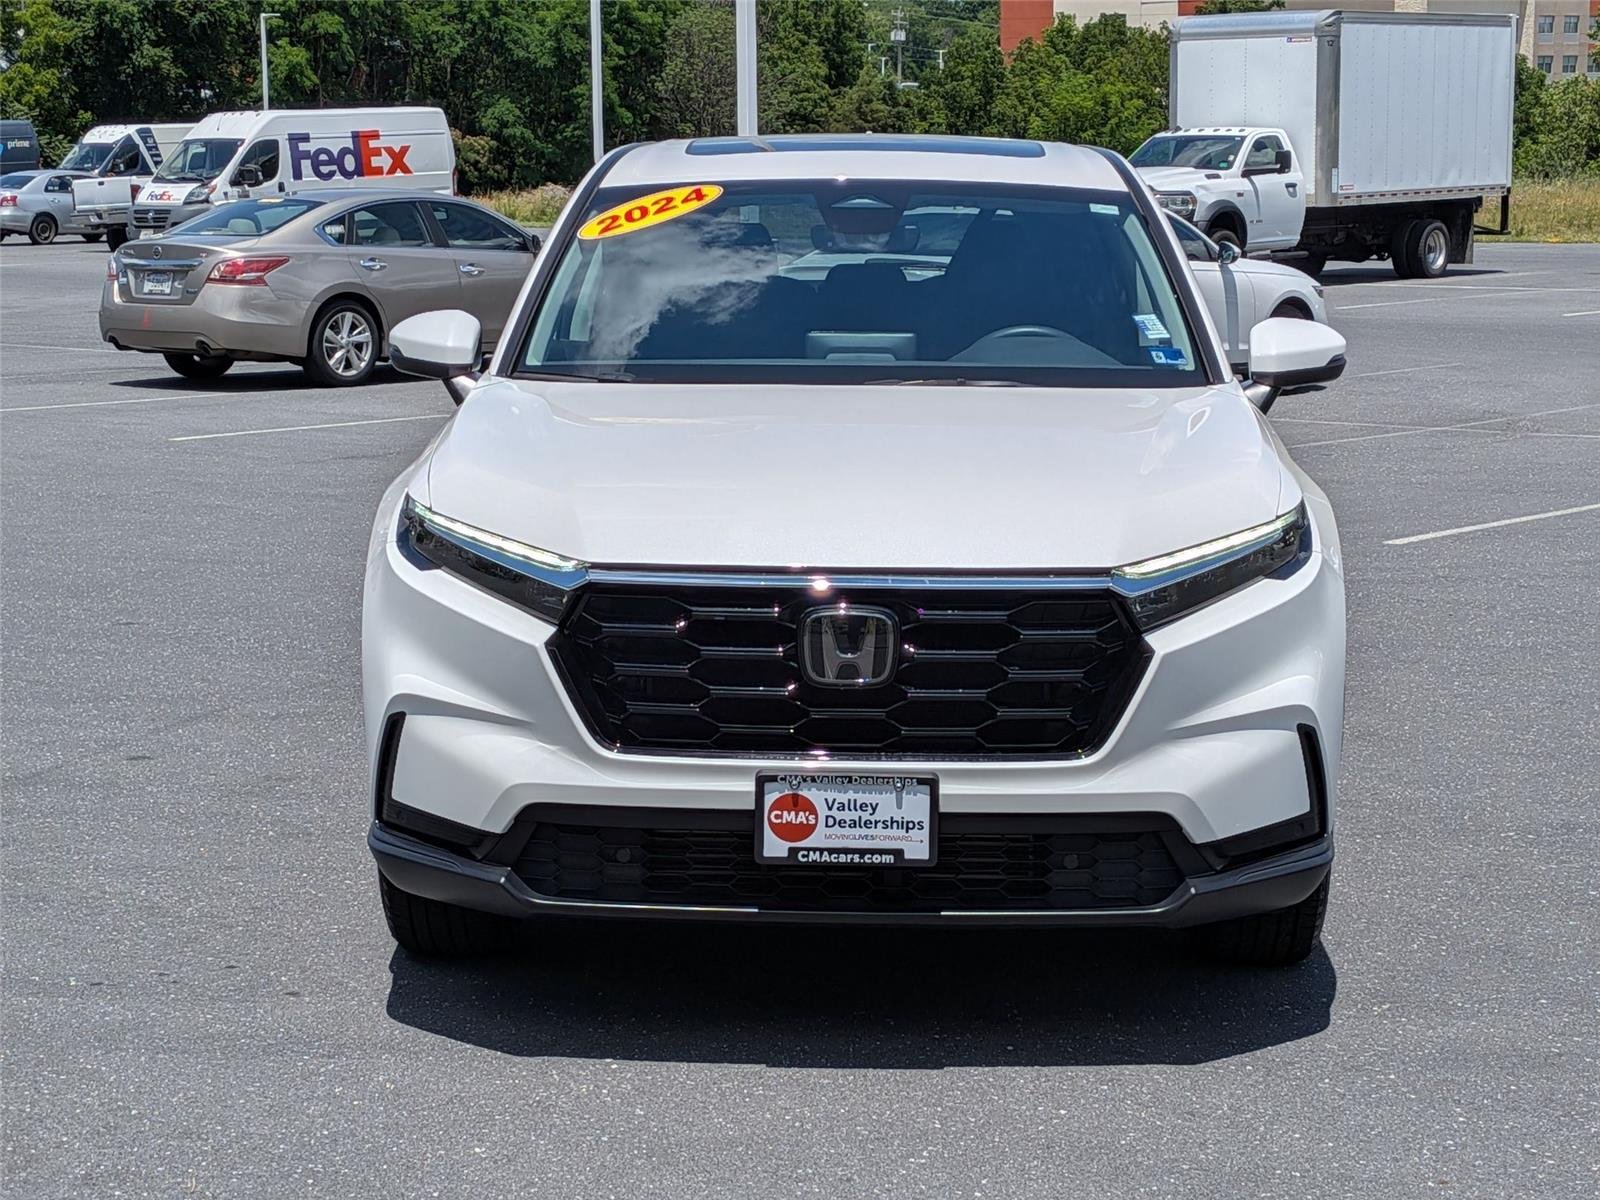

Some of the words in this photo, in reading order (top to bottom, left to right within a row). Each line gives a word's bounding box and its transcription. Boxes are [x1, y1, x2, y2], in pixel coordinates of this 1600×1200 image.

[7, 139, 30, 150] prime
[287, 129, 414, 182] FedEx
[596, 187, 710, 236] 2024
[815, 775, 849, 785] Valley
[824, 798, 880, 815] Valley
[770, 810, 816, 825] CMA's
[824, 815, 925, 834] Dealerships
[798, 850, 895, 864] CMAcars.com
